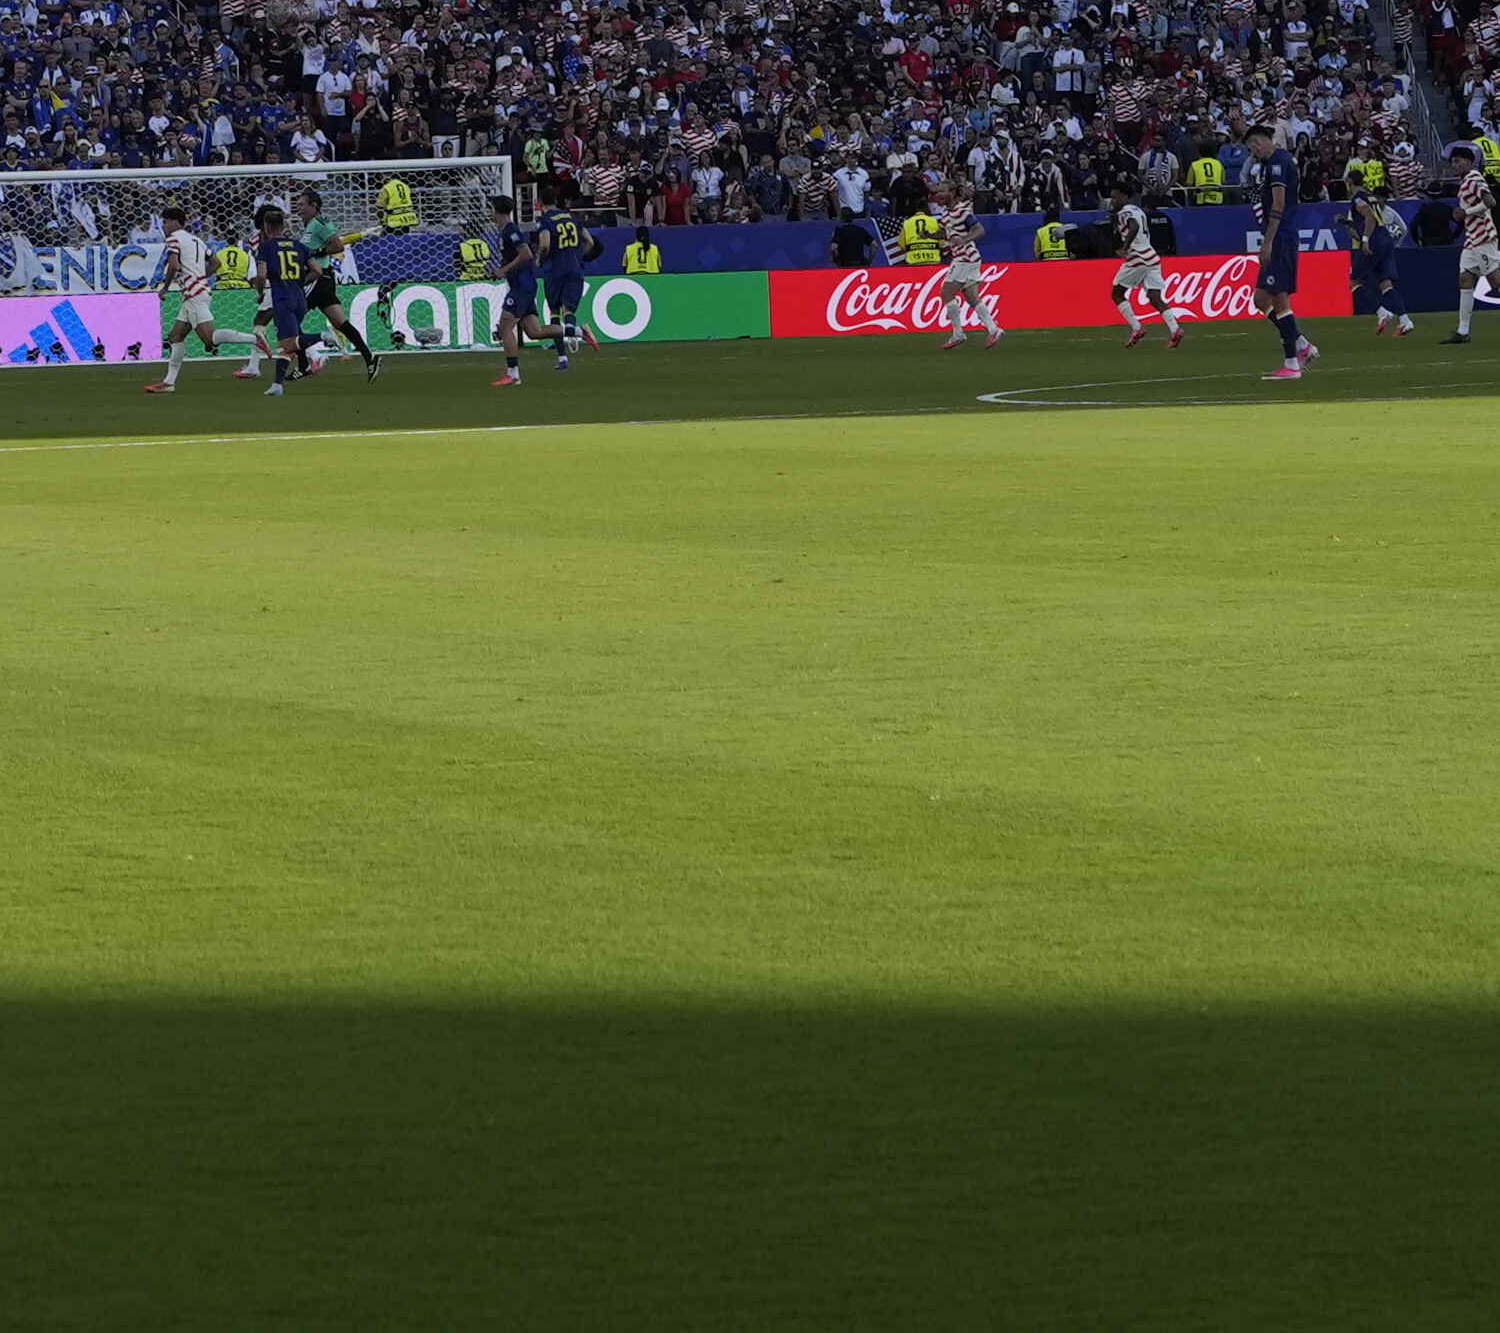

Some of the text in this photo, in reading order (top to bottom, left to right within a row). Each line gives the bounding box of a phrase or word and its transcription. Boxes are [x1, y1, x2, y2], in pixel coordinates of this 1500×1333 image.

[556, 222, 579, 249] 23
[30, 243, 171, 291] ENIC
[277, 250, 300, 280] 15
